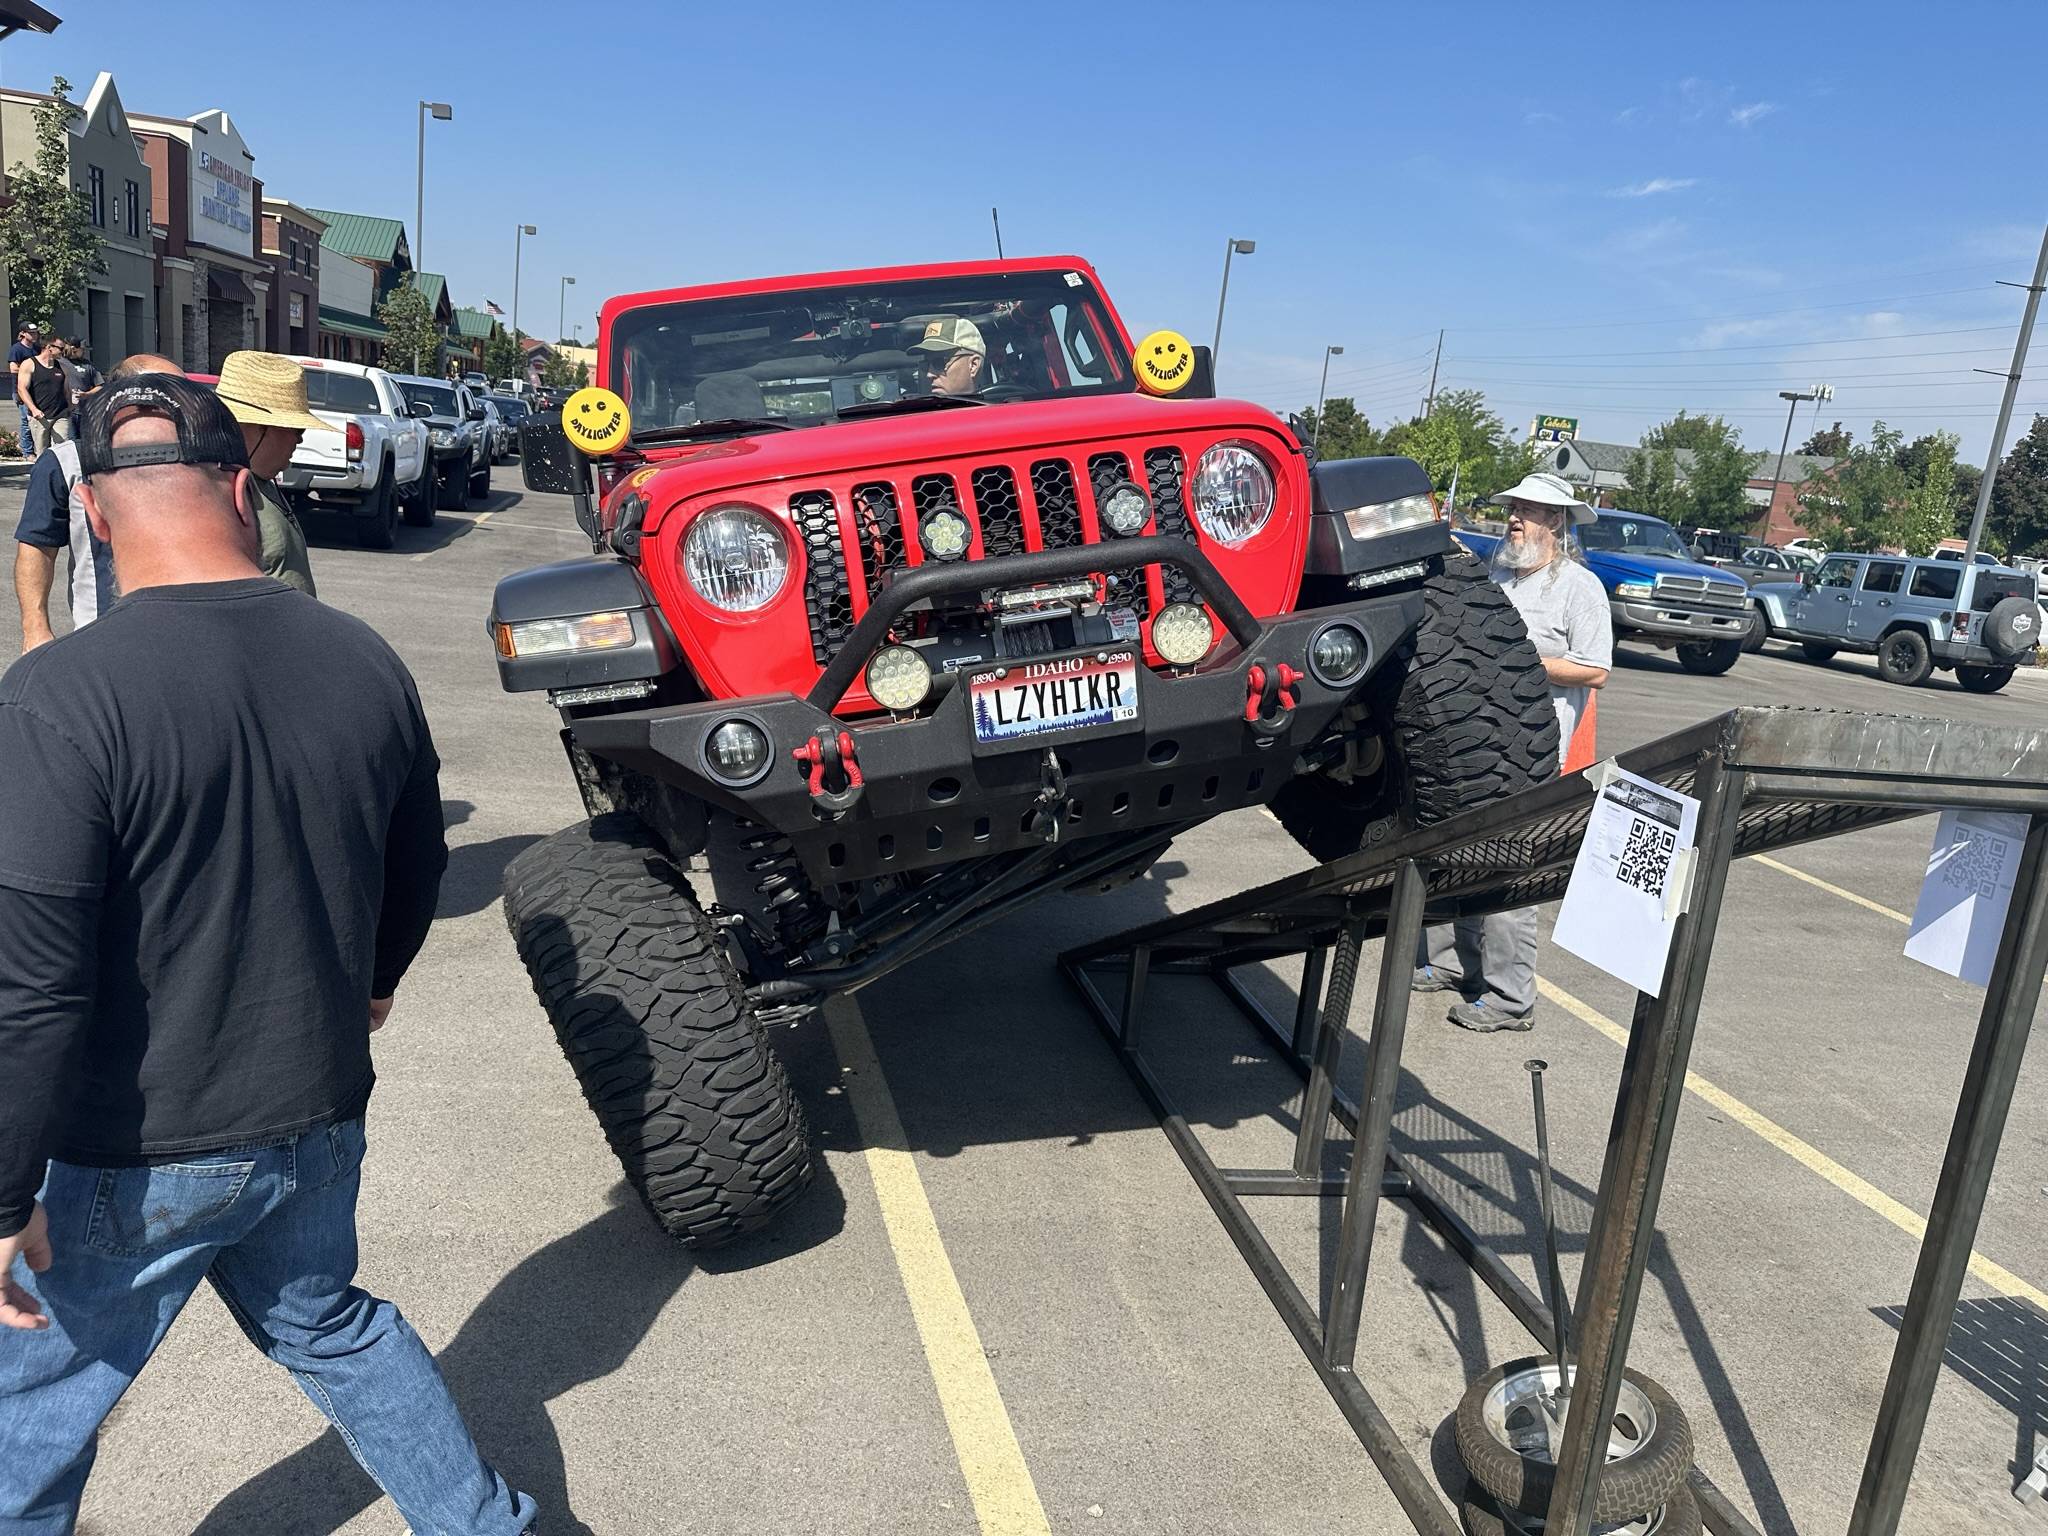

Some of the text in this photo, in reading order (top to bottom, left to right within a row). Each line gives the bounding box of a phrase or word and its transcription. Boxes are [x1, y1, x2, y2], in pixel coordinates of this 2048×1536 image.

[1145, 353, 1188, 380] DAYLIGHTER
[570, 411, 621, 440] DAYLIGHTER
[971, 672, 996, 685] 1890
[1024, 657, 1083, 679] IDAHO
[994, 671, 1122, 726] LZYHIKR
